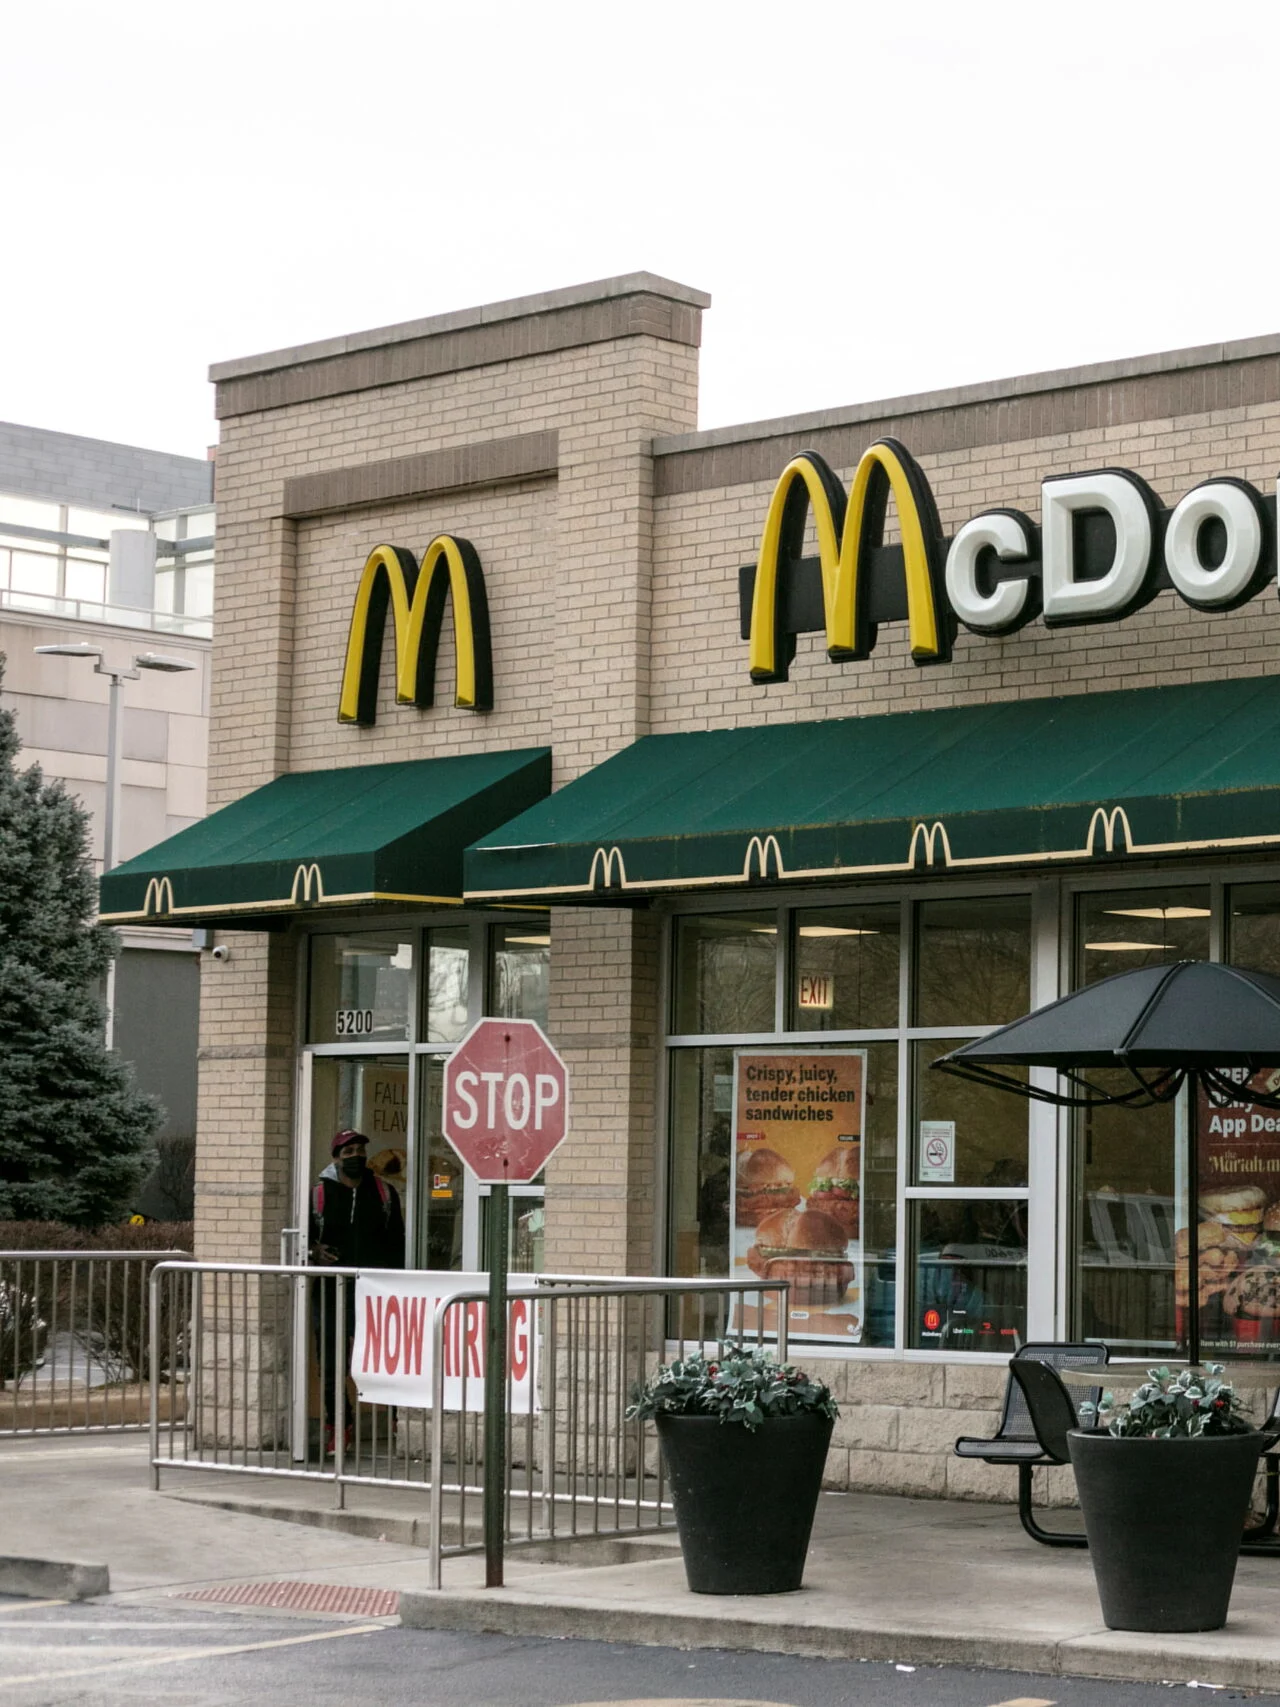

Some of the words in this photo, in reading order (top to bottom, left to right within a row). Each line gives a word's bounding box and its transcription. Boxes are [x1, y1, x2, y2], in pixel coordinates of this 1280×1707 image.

[800, 976, 830, 1005] EXIT
[337, 1010, 373, 1033] 5200
[746, 1065, 797, 1085] Crispy,
[798, 1064, 838, 1085] juicy,
[374, 1082, 409, 1105] FALL
[453, 1071, 560, 1130] STOP
[746, 1087, 795, 1102] tender
[797, 1086, 855, 1102] chicken
[373, 1110, 408, 1132] FLAV
[746, 1104, 834, 1121] sandwiches
[1208, 1115, 1247, 1138] App
[362, 1295, 427, 1376] NOW
[1237, 1341, 1265, 1350] purchase
